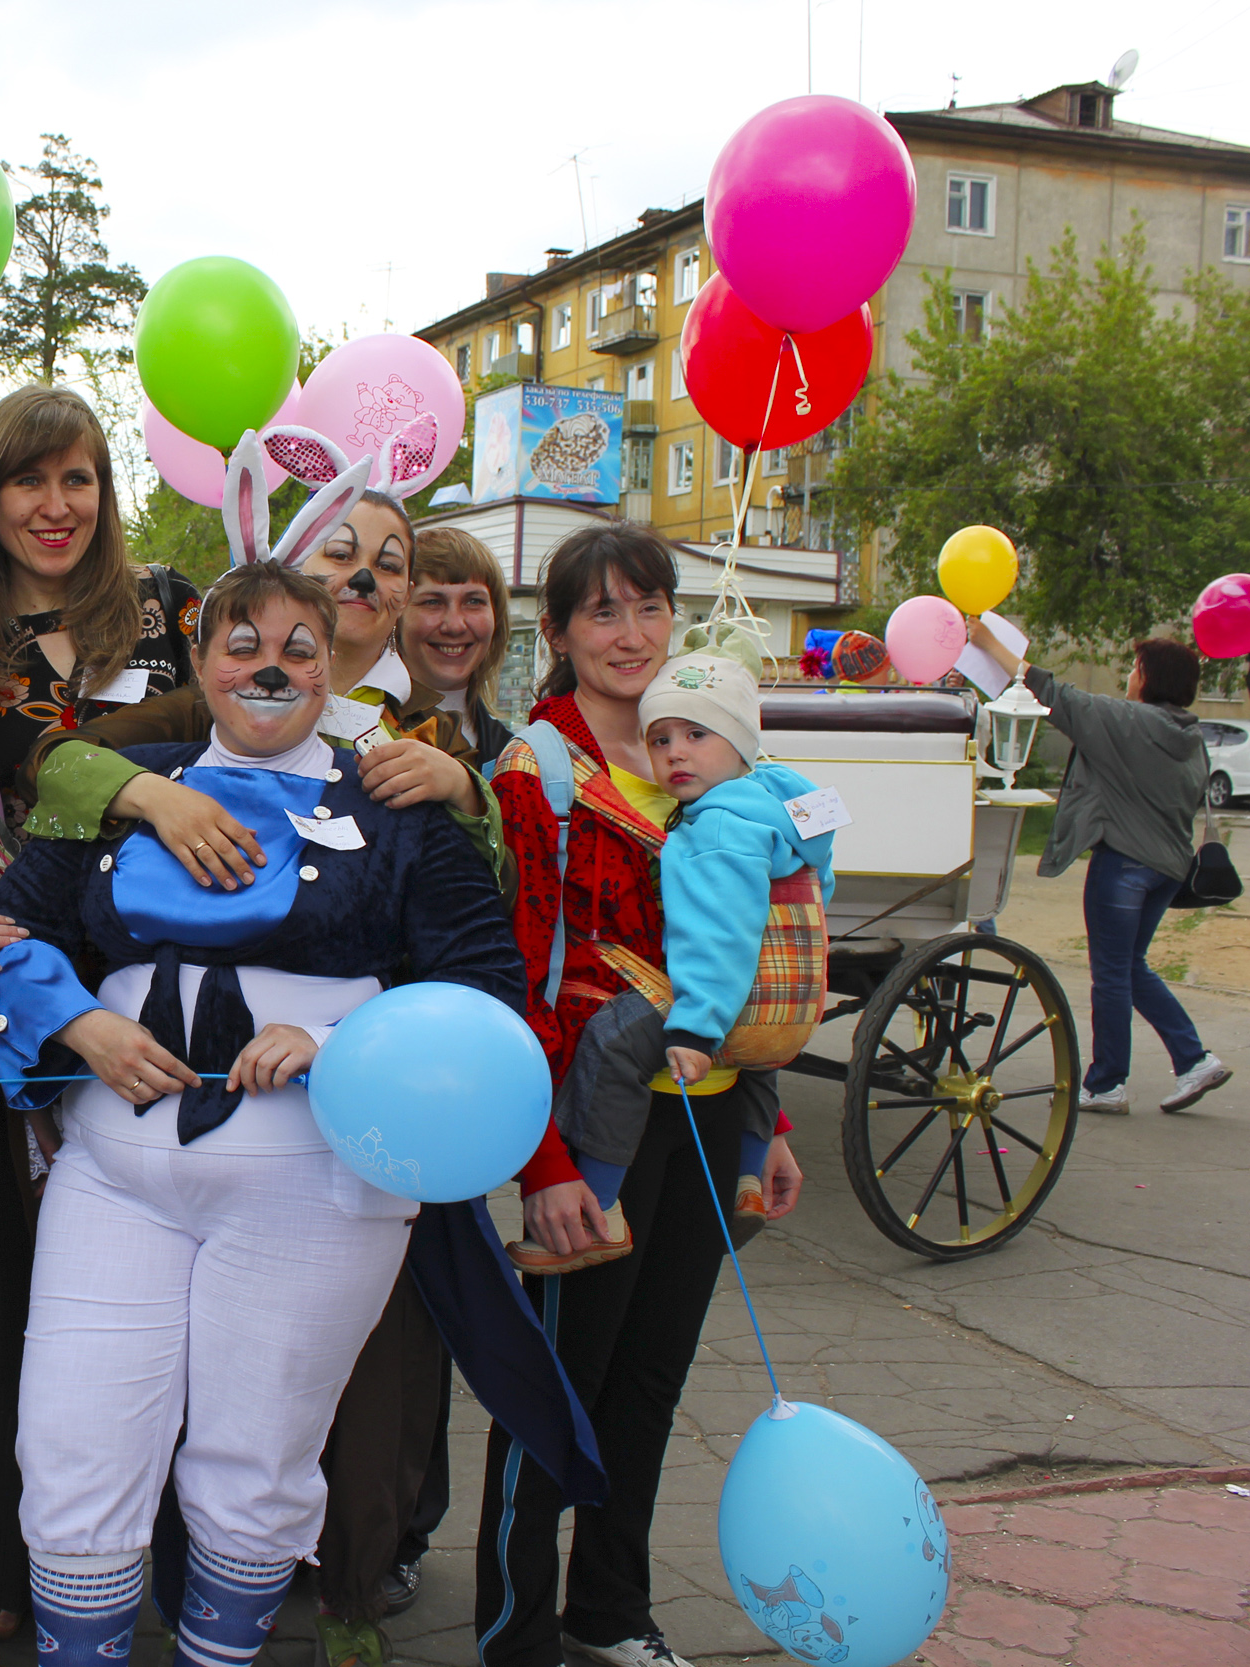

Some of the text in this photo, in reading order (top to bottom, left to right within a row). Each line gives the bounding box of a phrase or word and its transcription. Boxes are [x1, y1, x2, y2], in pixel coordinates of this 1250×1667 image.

[558, 388, 570, 397] по
[572, 391, 622, 402] телефонам
[523, 395, 570, 409] 530-737
[576, 399, 622, 415] 535-506
